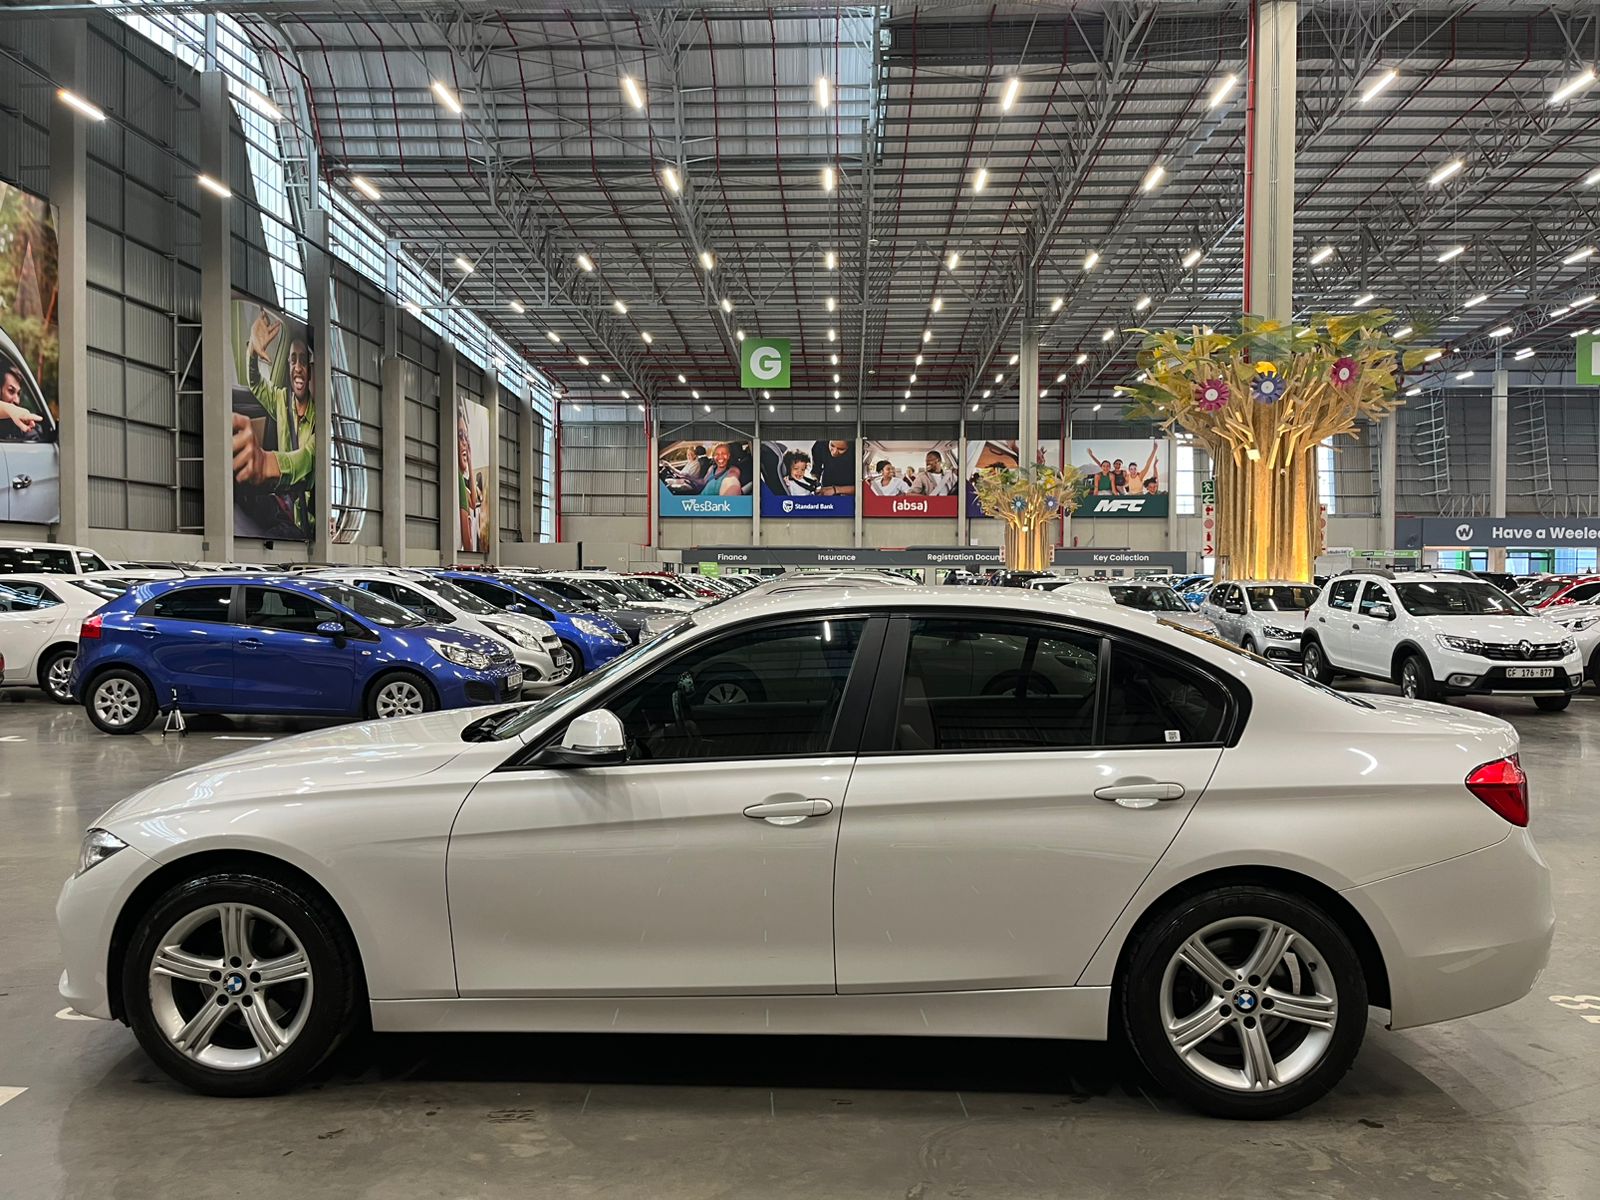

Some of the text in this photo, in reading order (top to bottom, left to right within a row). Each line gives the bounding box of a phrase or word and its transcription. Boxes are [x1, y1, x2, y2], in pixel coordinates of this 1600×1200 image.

[750, 346, 781, 380] G
[682, 499, 731, 512] WesBank
[892, 499, 928, 513] (absa)
[1094, 499, 1146, 512] MFC
[1492, 526, 1600, 539] Have a Weele
[717, 553, 748, 561] Finance
[817, 553, 856, 561] Insurance
[927, 553, 974, 563] Registration
[1093, 554, 1108, 563] Key
